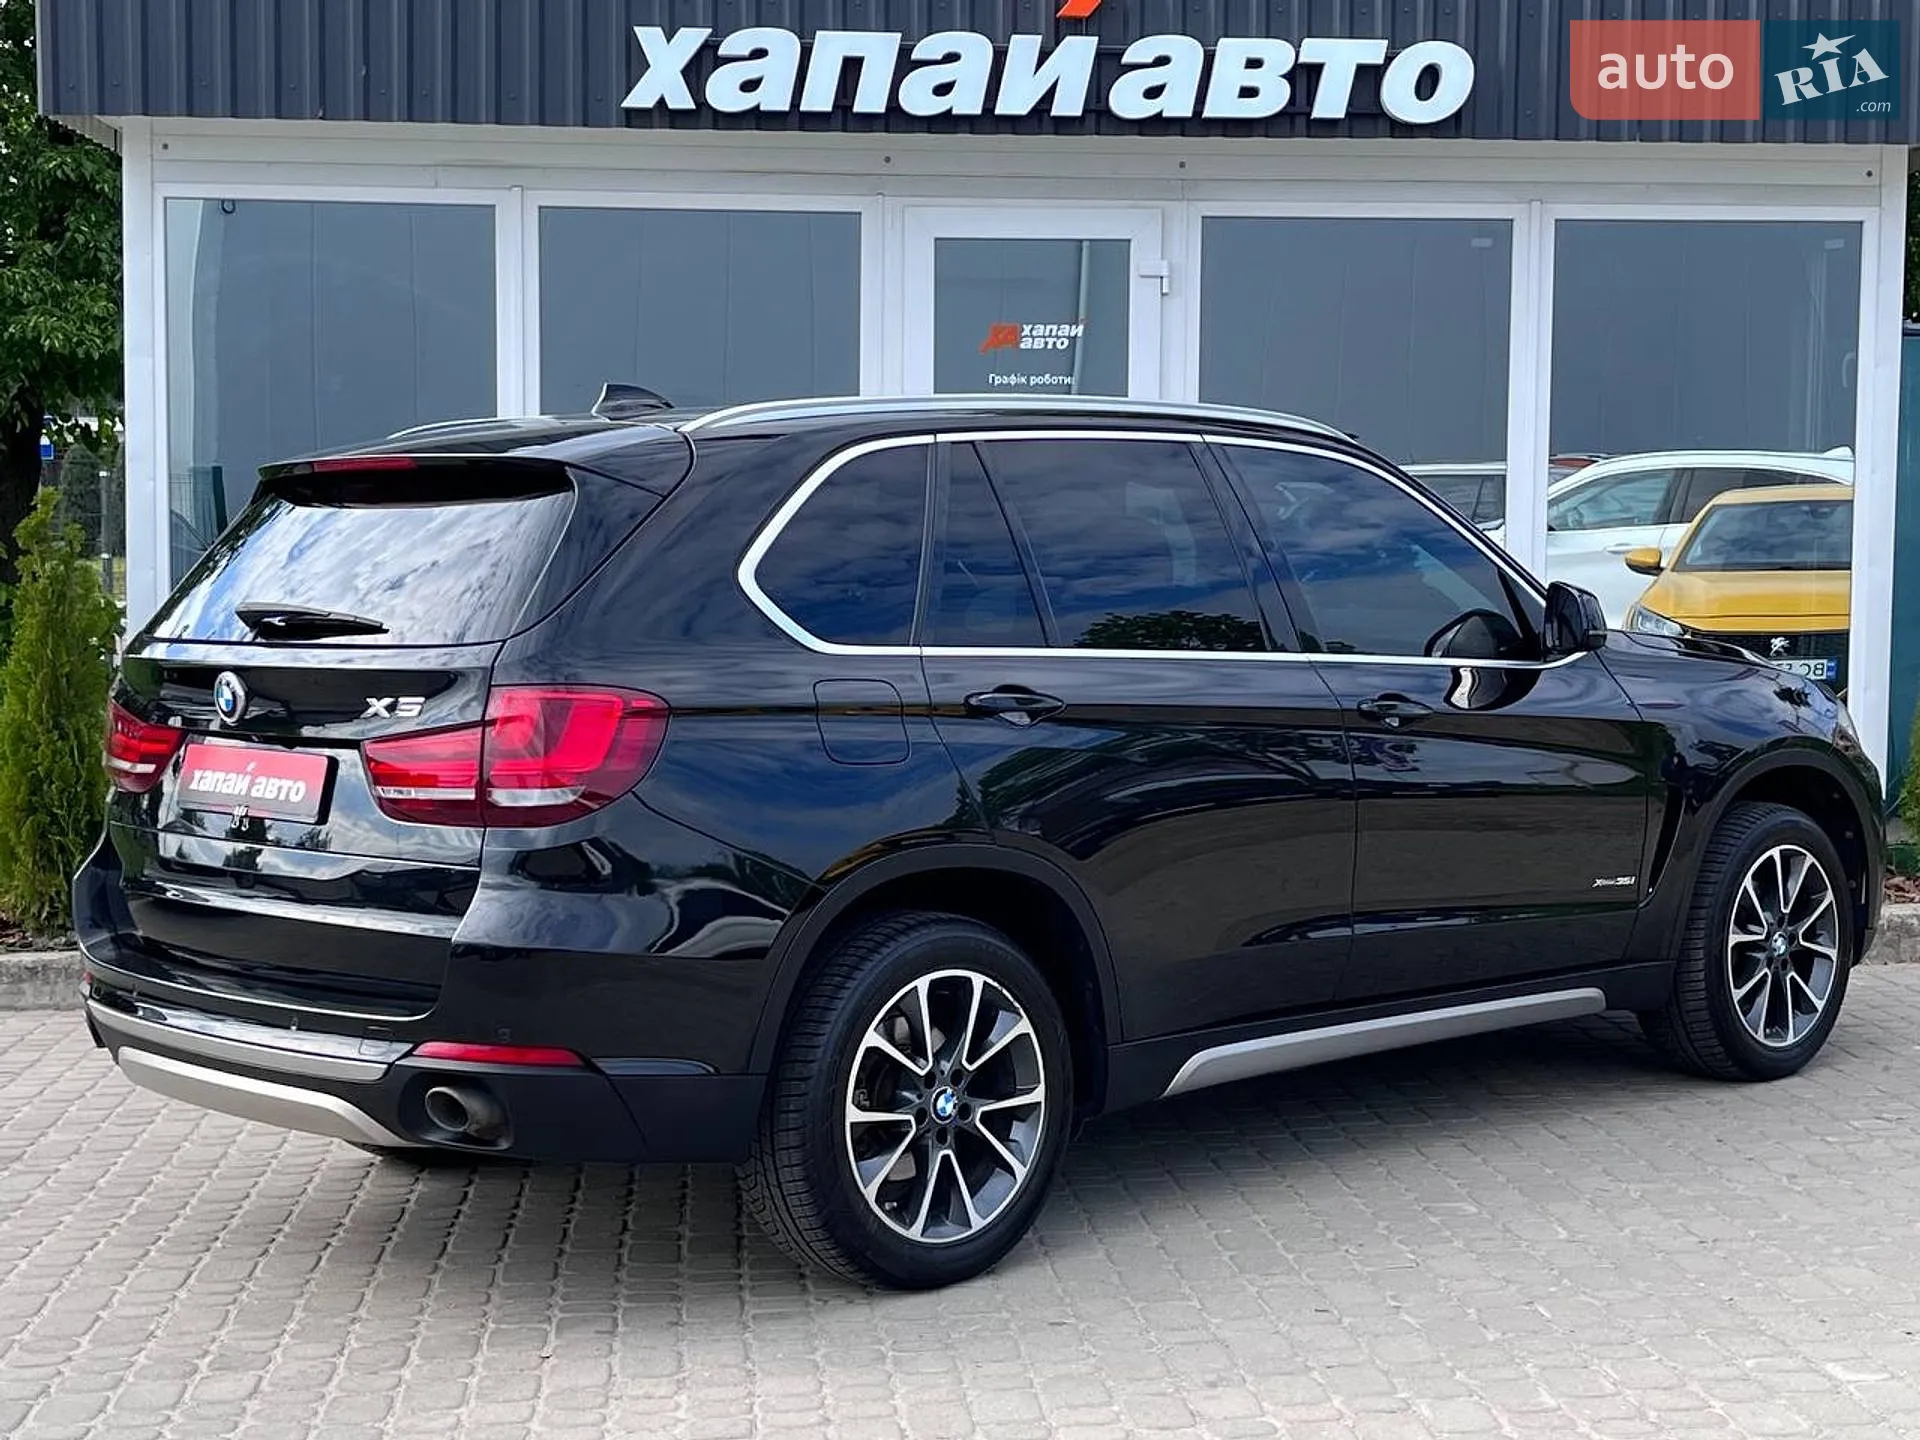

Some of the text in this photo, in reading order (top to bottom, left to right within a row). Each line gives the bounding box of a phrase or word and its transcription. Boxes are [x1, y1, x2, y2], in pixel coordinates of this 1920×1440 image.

[1108, 34, 1476, 125] авто
[1020, 337, 1070, 349] авто
[988, 372, 1027, 386] Графік
[360, 696, 427, 718] X5
[189, 761, 307, 803] хапай авто
